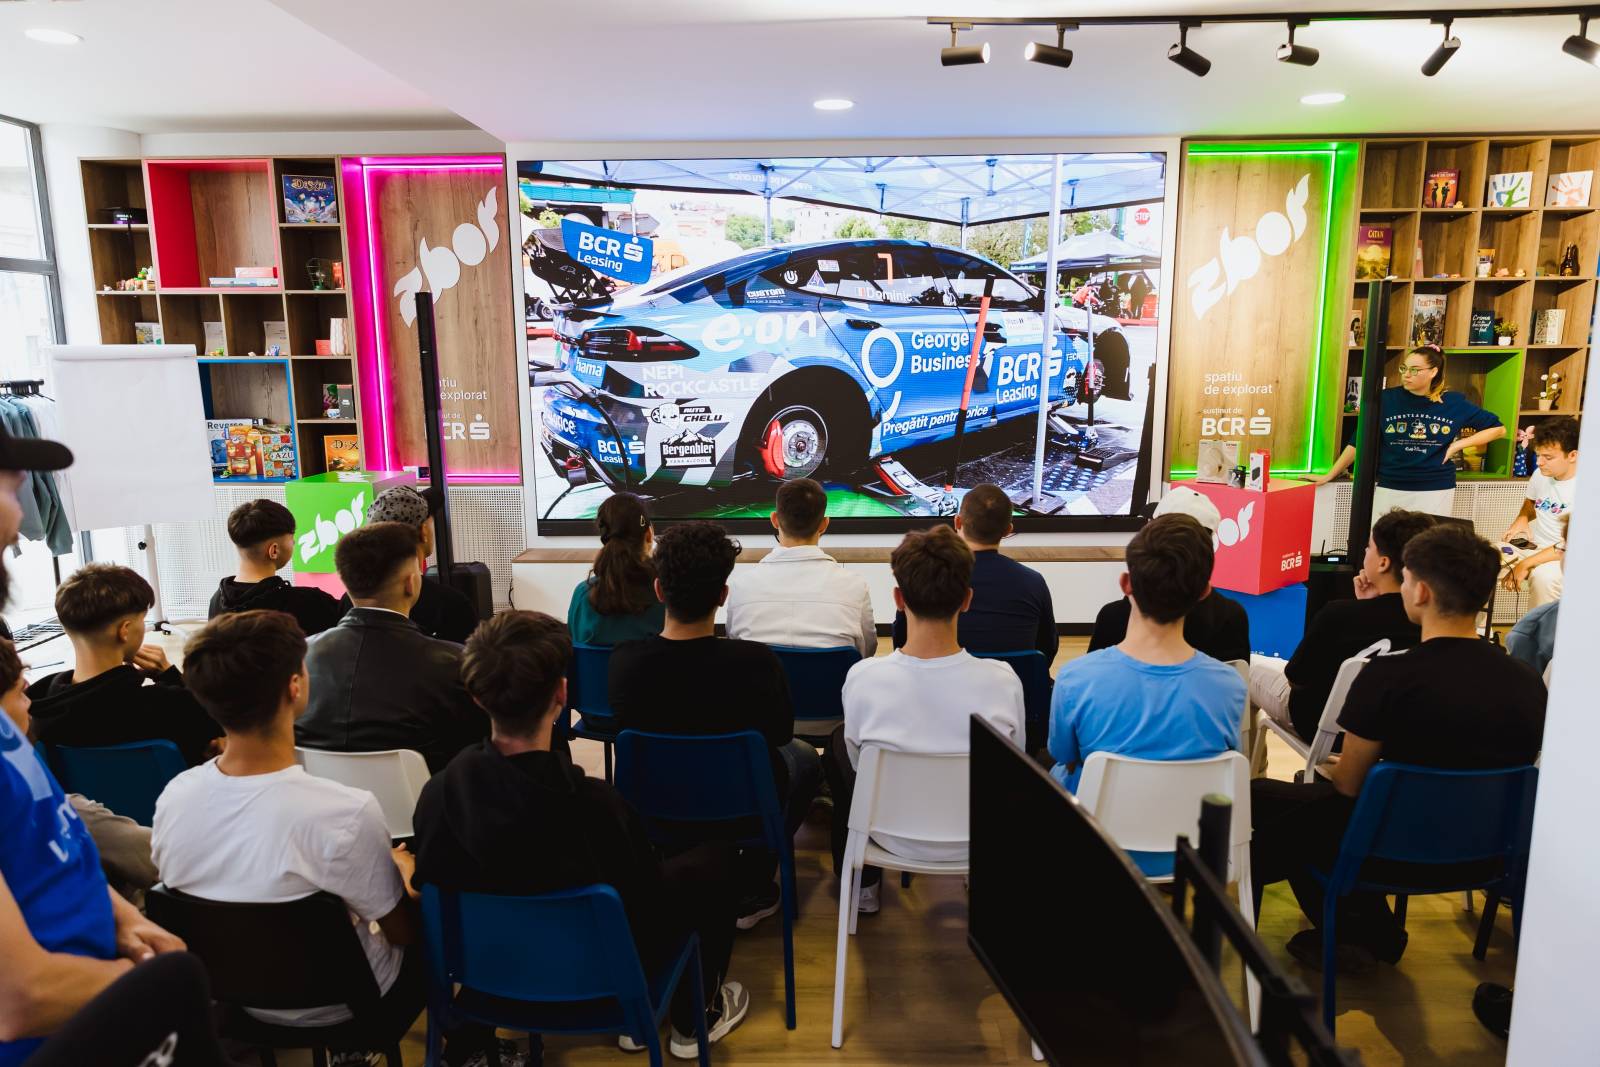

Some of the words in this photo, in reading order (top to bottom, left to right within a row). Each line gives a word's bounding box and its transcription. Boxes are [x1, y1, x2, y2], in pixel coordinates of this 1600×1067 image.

[579, 231, 621, 258] BCR
[576, 251, 623, 273] Leasing
[911, 331, 970, 352] George
[575, 357, 603, 377] hama
[641, 365, 684, 380] NEPI
[997, 352, 1042, 386] BCR
[440, 390, 488, 402] explorat
[643, 375, 761, 398] ROCKCASTLE
[996, 383, 1038, 405] Leasing
[1204, 384, 1220, 395] de
[1222, 383, 1273, 397] explorat
[683, 414, 723, 423] CHELU
[882, 414, 929, 436] Pregătit
[929, 410, 959, 429] pentr
[1201, 416, 1247, 437] BCR
[662, 442, 715, 457] Bergenbier
[1281, 557, 1295, 571] BCR
